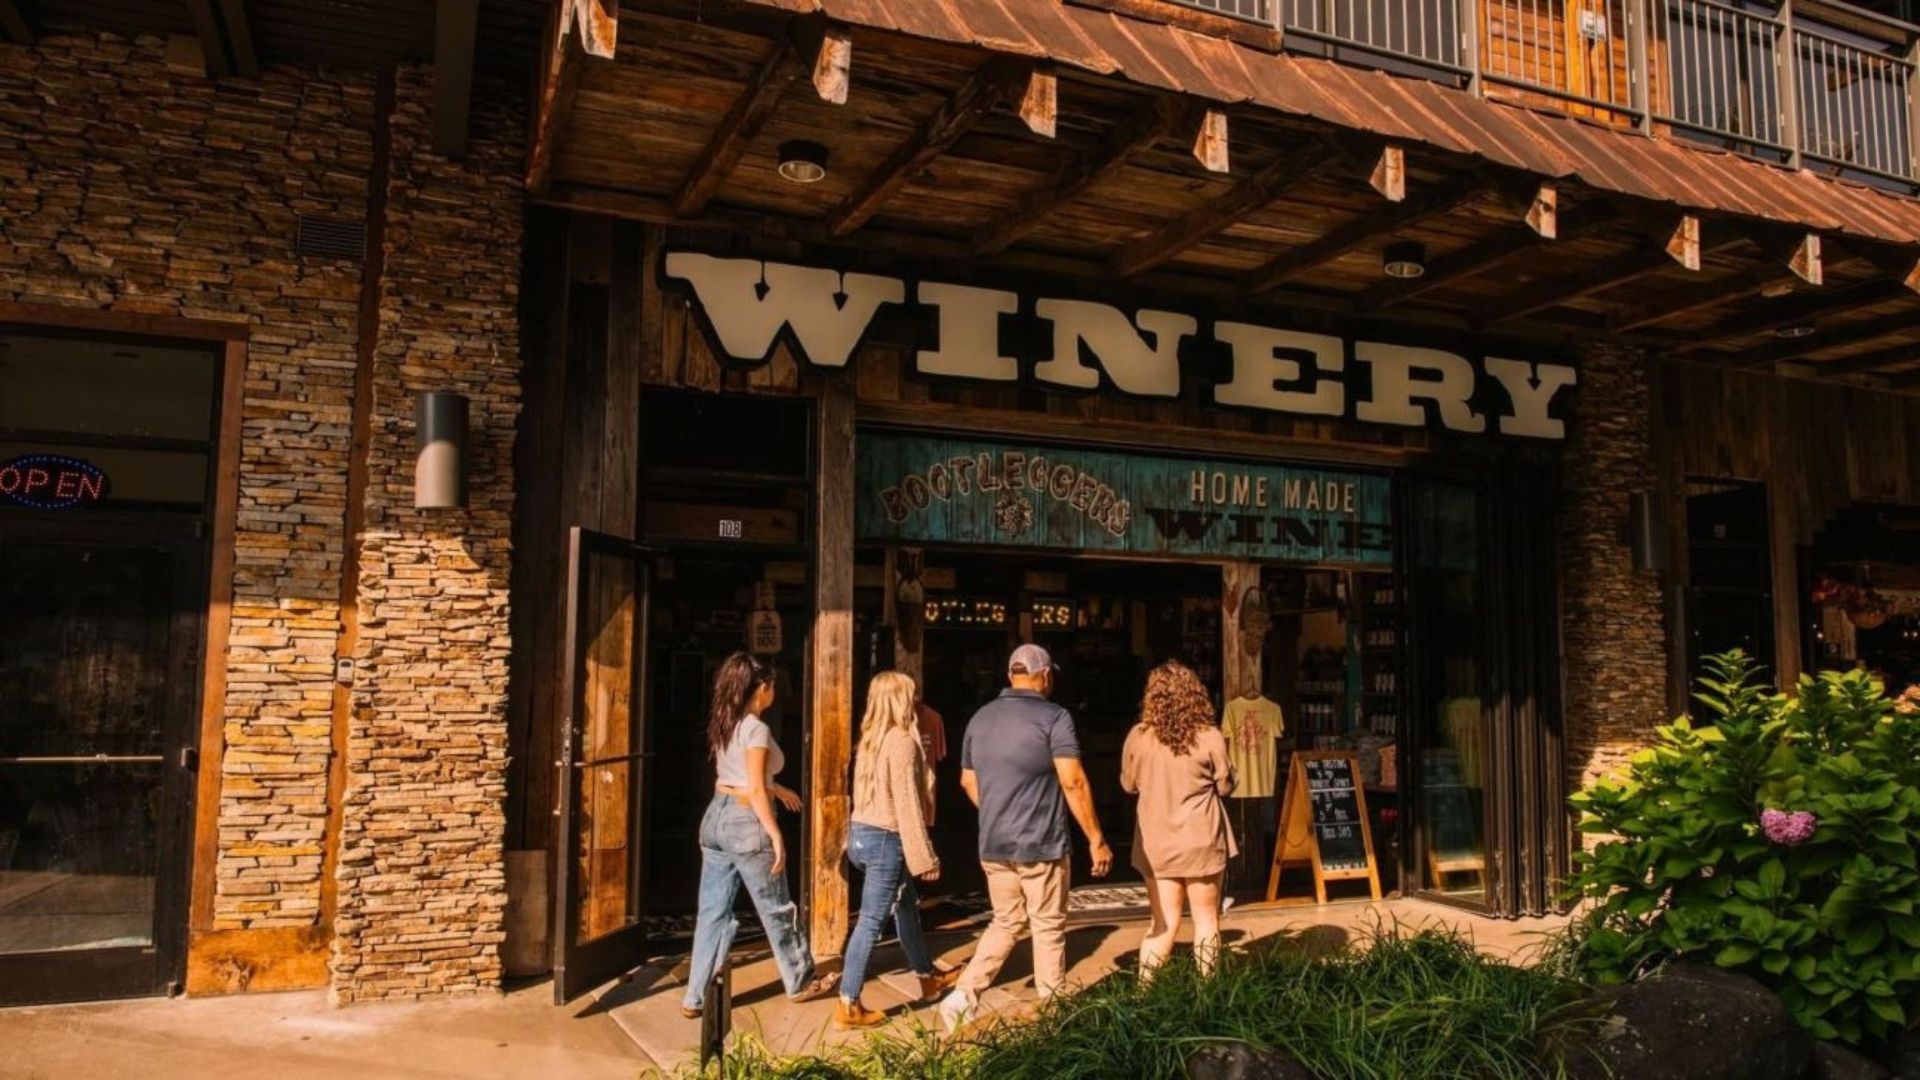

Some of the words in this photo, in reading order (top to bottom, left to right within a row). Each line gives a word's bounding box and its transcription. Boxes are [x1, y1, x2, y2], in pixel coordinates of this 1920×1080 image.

[665, 252, 1577, 439] WINERY
[0, 467, 104, 500] OPEN
[880, 452, 1130, 536] BOOTLEGGERS
[1190, 470, 1267, 507] HOME
[1284, 479, 1355, 512] MADE
[719, 520, 742, 538] 108
[1145, 508, 1392, 549] WINE
